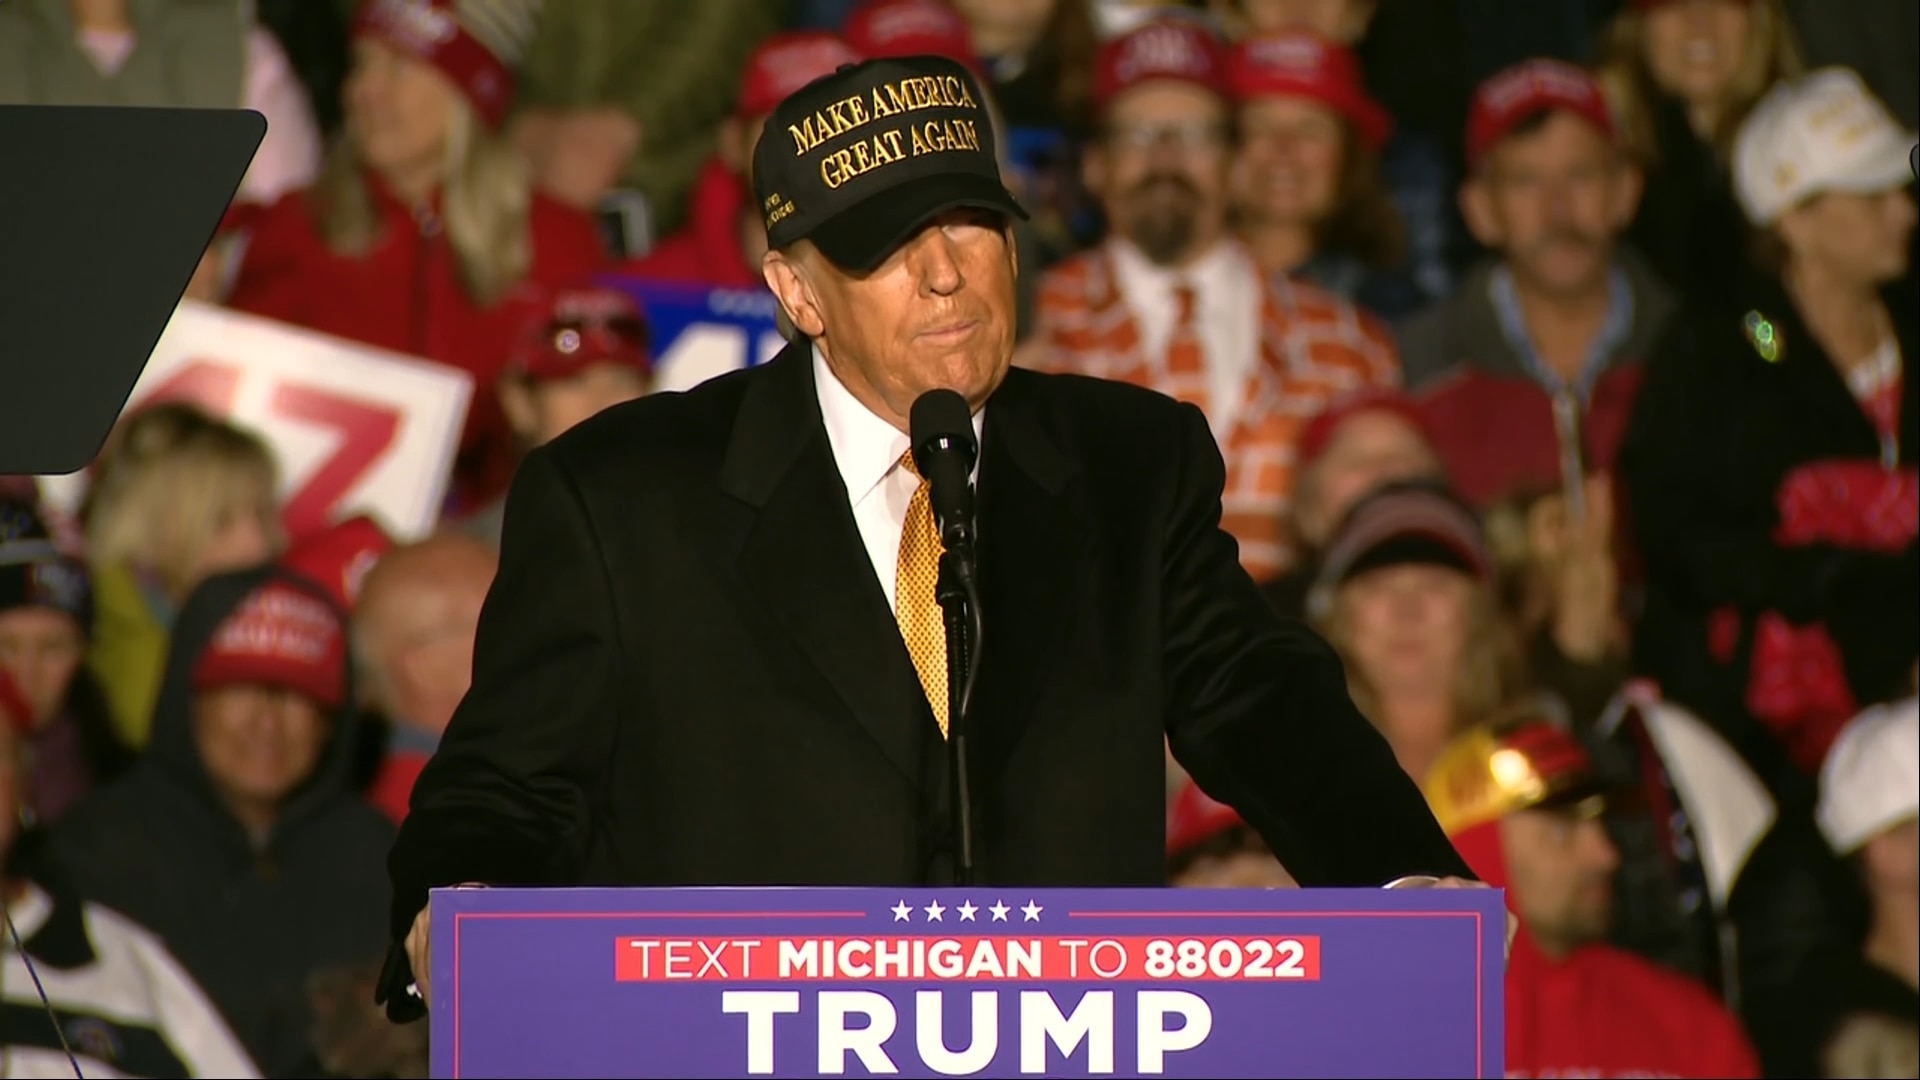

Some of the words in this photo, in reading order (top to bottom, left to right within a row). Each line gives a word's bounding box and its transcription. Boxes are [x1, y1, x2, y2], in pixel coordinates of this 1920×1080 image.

[788, 95, 870, 156] MAKE
[872, 75, 977, 119] AMERICA
[820, 129, 906, 189] GREAT
[910, 119, 980, 156] AGAIN
[631, 940, 761, 978] TEXT
[778, 939, 1042, 979] MICHIGAN
[1059, 940, 1128, 978] TO
[1144, 939, 1305, 978] 88022
[722, 990, 1213, 1076] TRUMP
